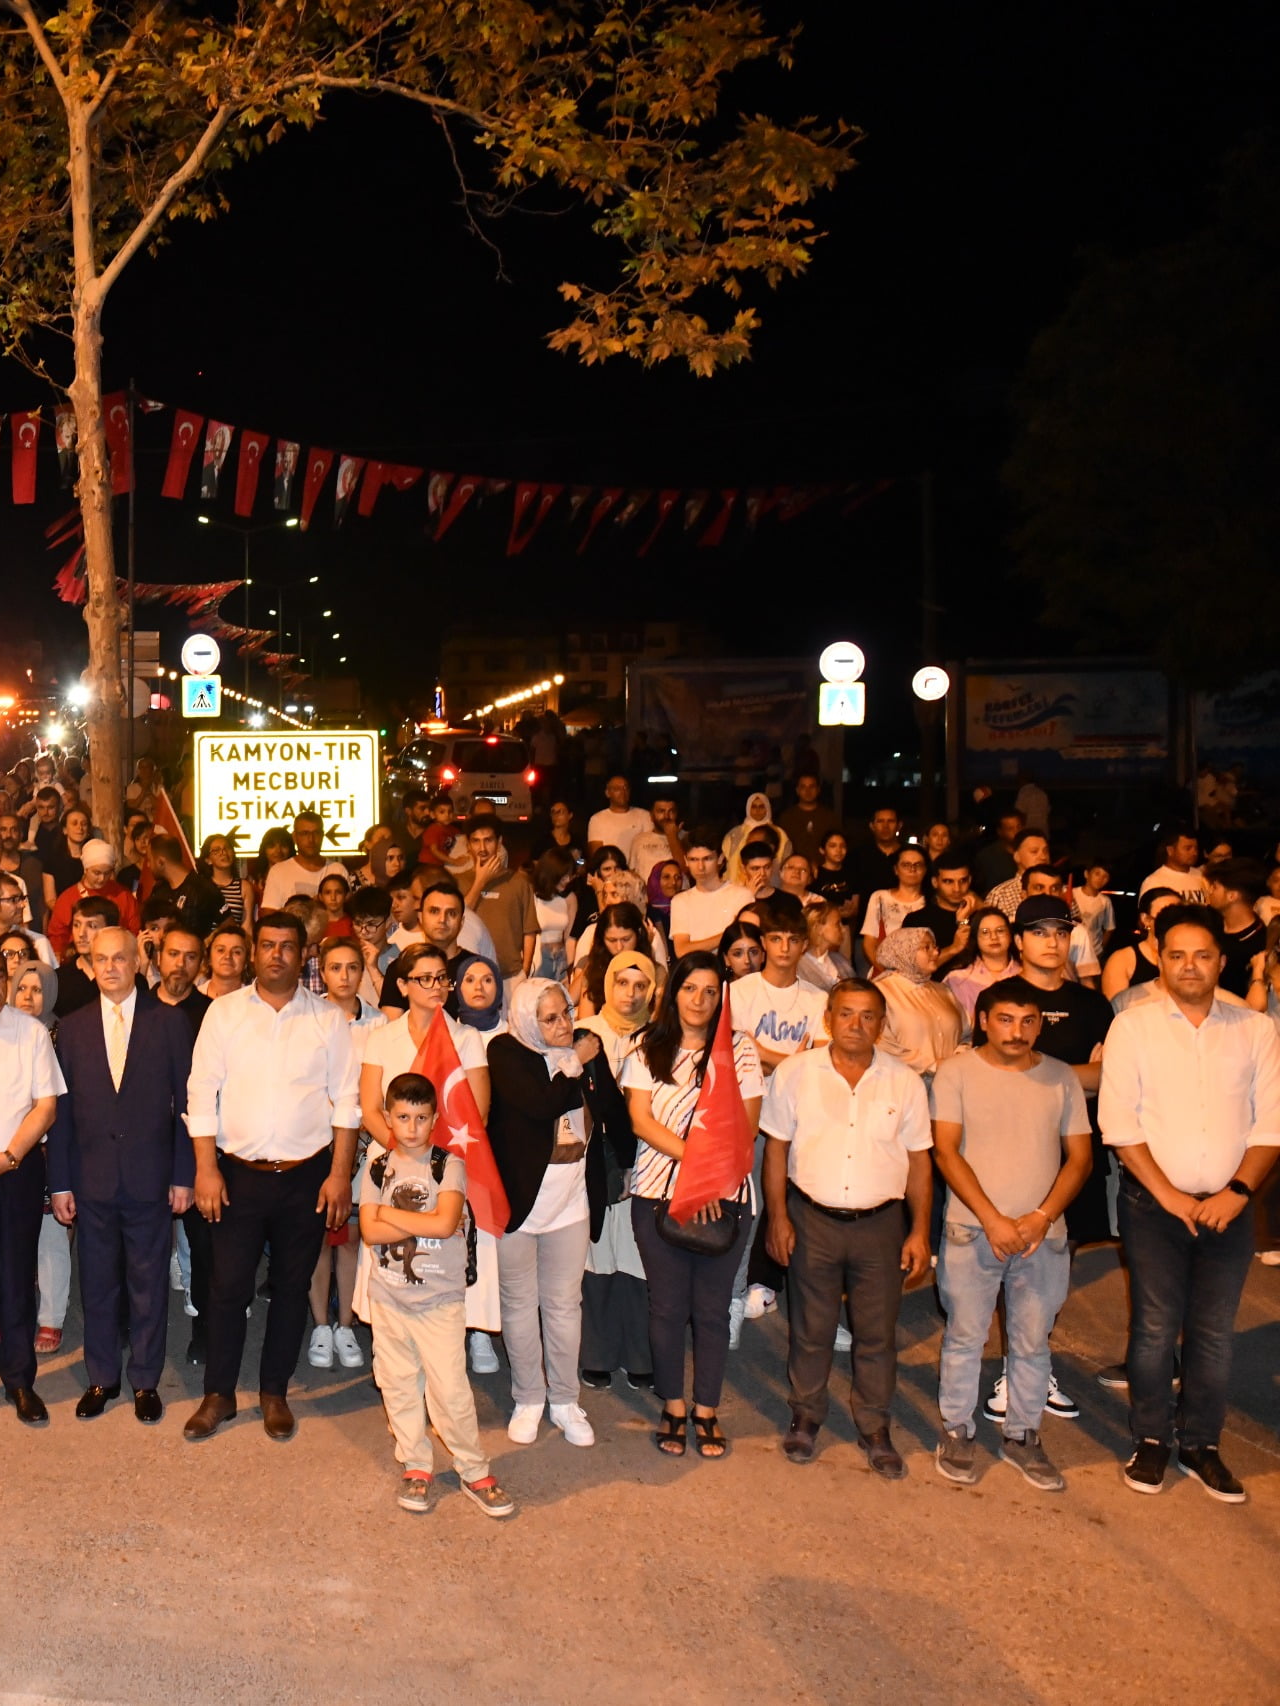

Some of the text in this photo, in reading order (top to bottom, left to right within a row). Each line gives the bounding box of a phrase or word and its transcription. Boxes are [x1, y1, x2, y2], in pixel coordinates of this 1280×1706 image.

[210, 742, 362, 762] KAMYON-TIR
[233, 765, 340, 791] MECBURİ
[218, 794, 355, 820] İSTİKAMETİ
